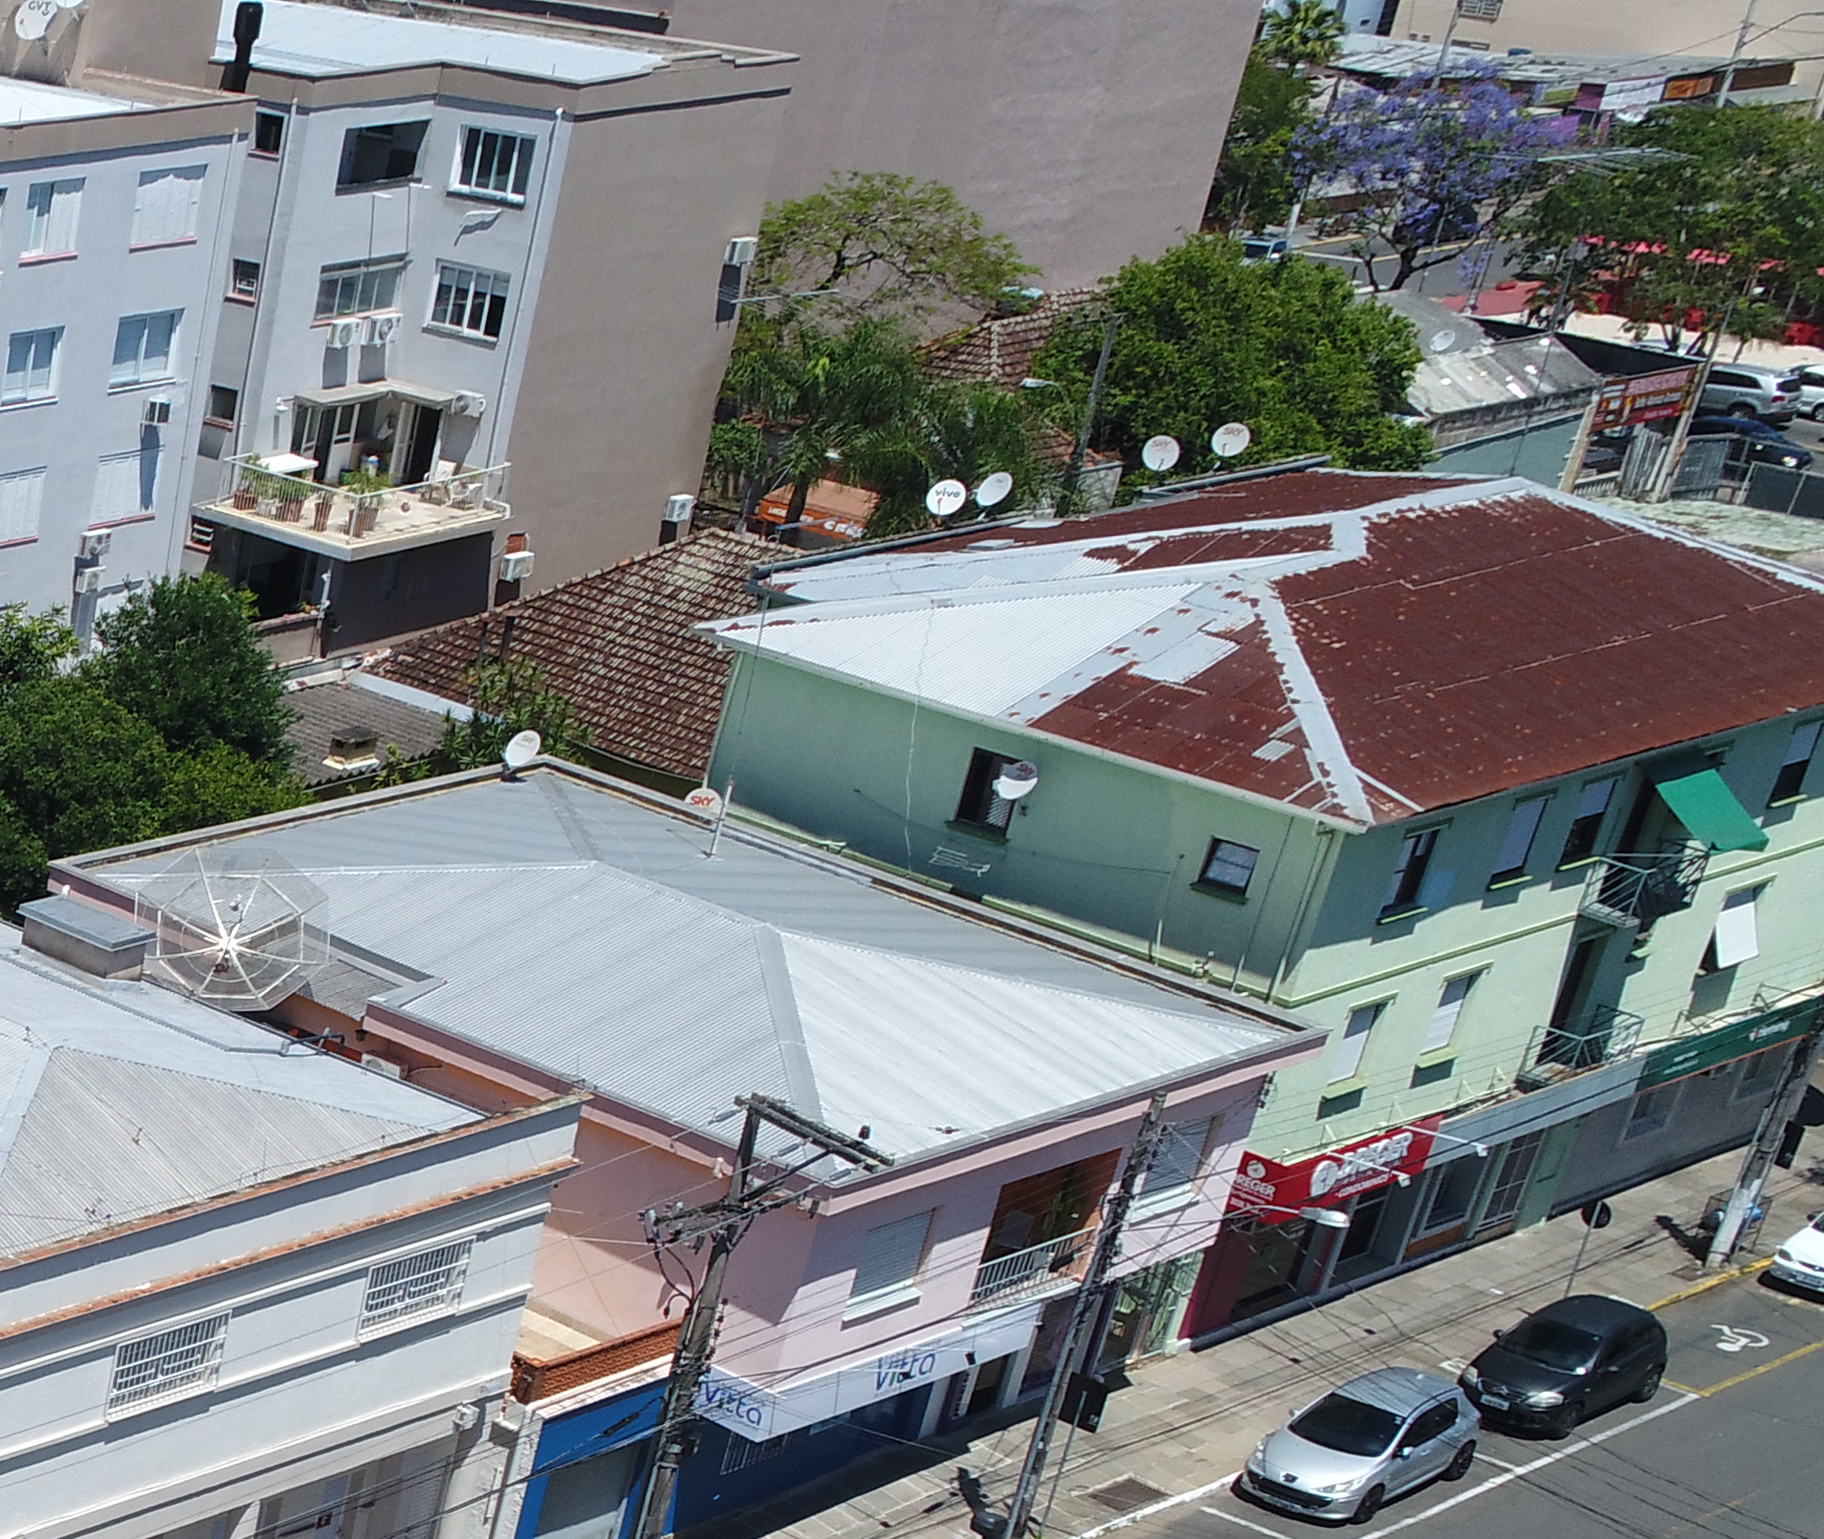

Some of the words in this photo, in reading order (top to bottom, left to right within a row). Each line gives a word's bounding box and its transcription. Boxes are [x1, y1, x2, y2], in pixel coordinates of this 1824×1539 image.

[27, 1, 51, 11] GVT
[935, 487, 961, 499] vivo
[690, 796, 715, 807] SKY
